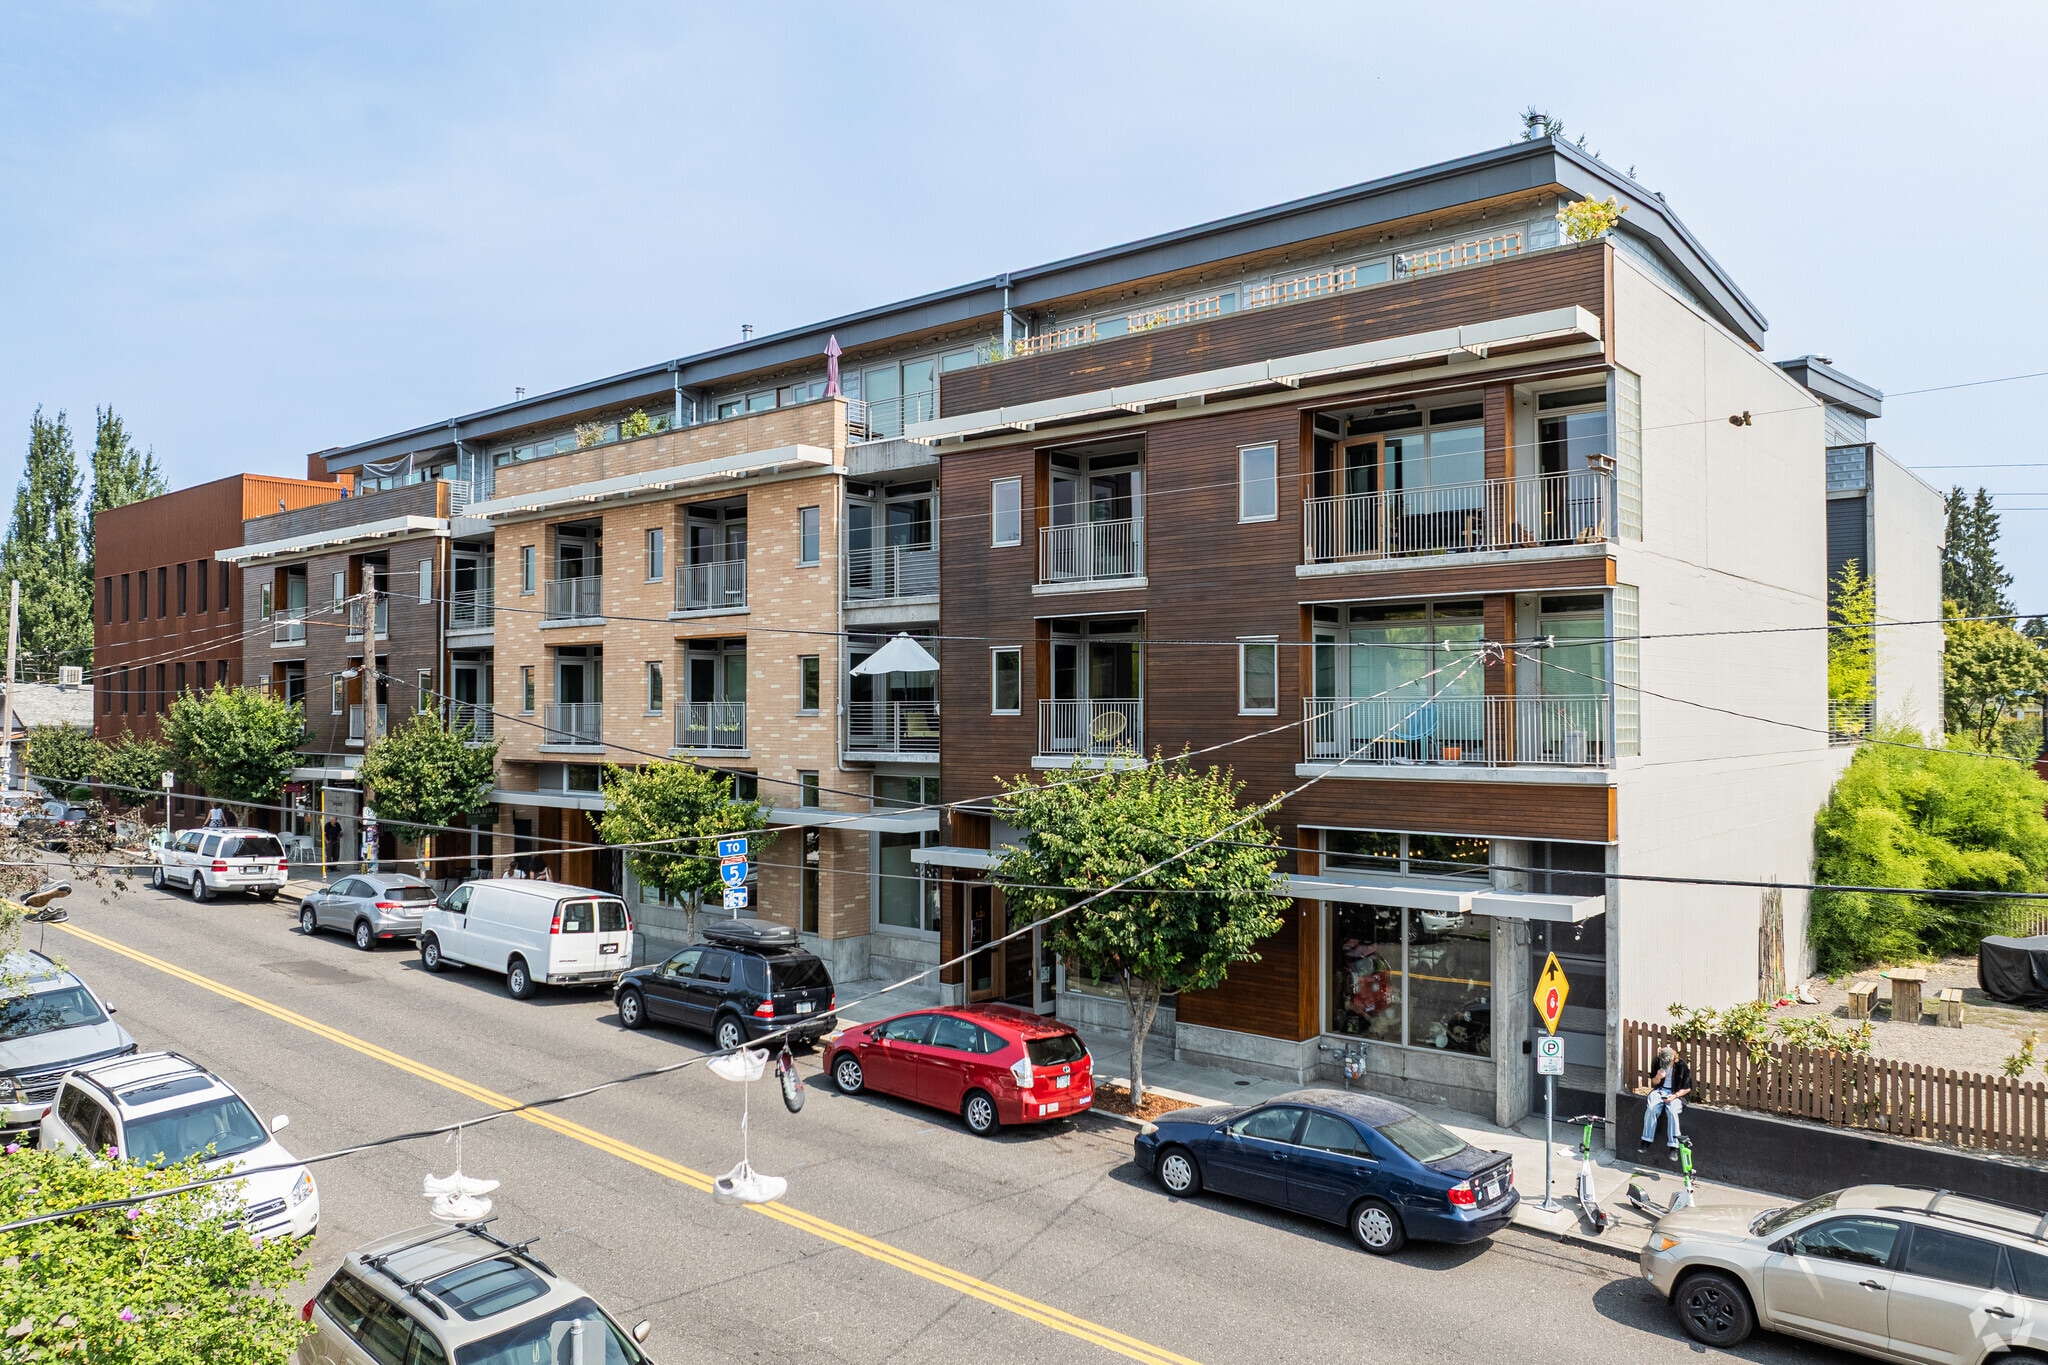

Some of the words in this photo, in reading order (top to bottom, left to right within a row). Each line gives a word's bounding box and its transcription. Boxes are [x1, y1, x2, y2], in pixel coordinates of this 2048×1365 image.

[726, 843, 740, 853] TO
[730, 866, 740, 881] 5
[1547, 1043, 1556, 1053] P
